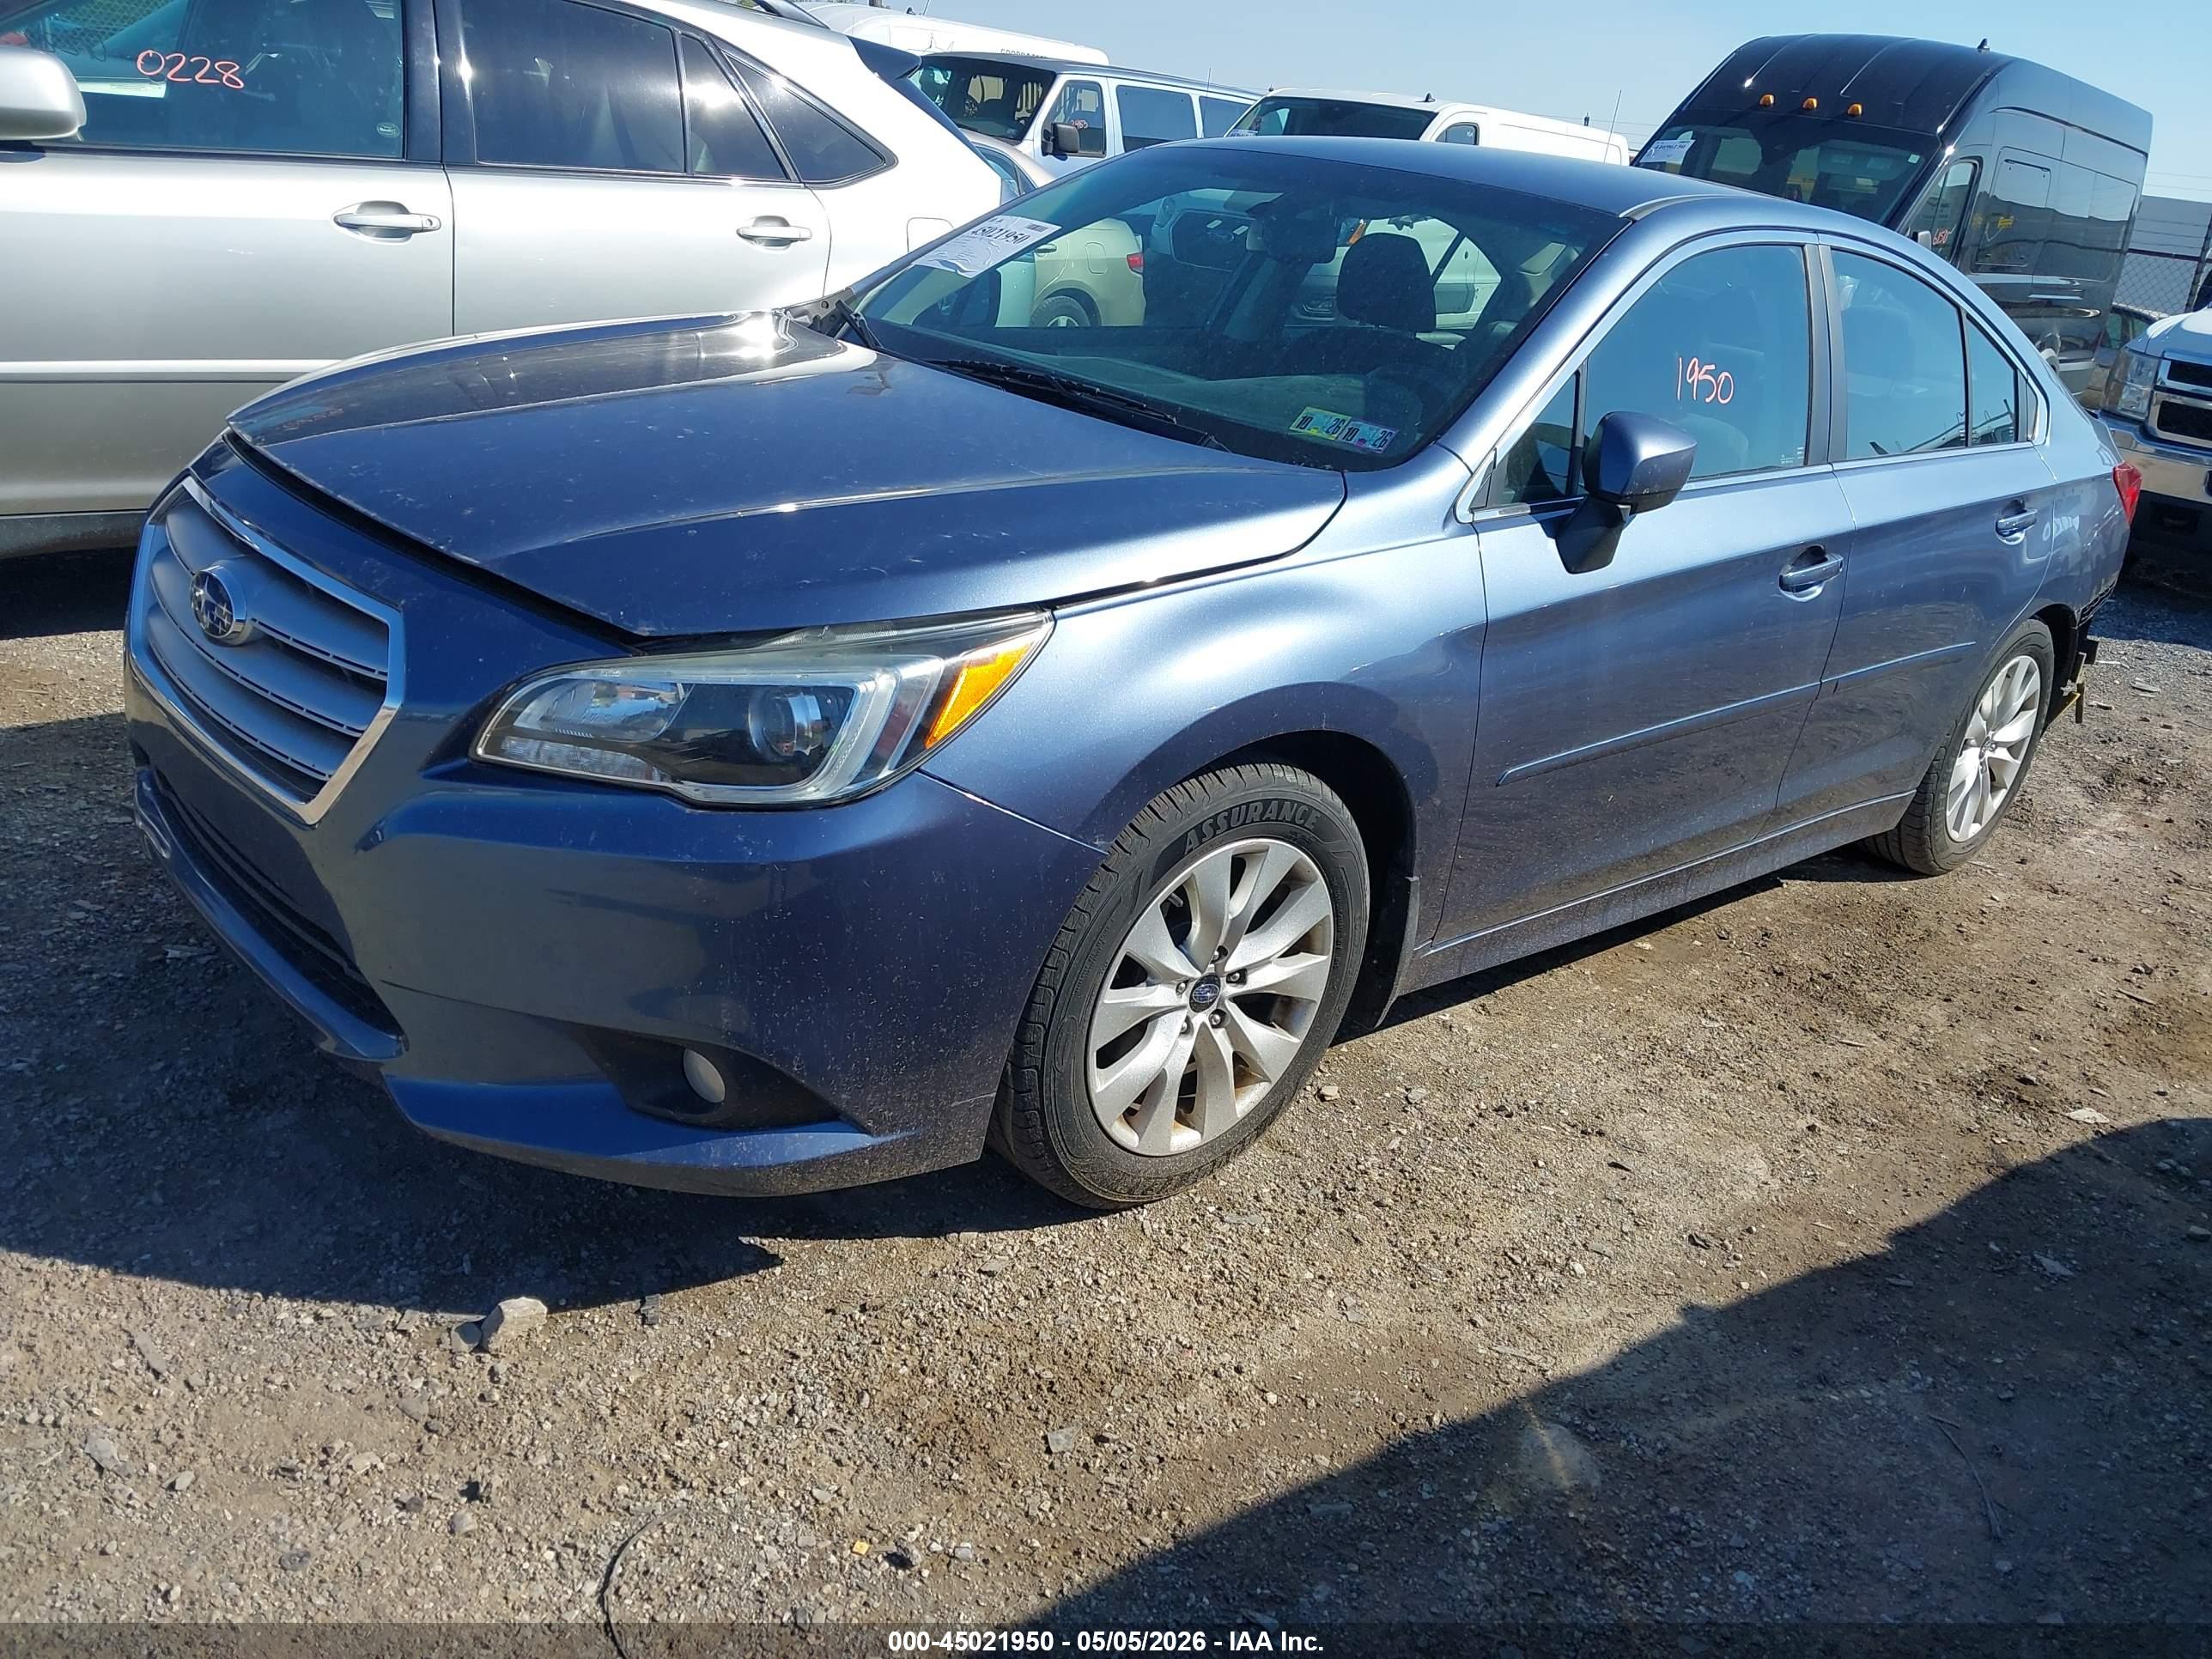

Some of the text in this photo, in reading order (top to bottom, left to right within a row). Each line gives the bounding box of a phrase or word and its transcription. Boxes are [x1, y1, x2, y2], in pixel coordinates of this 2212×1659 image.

[137, 49, 245, 89] 0228
[970, 225, 1031, 245] 45021950
[1677, 356, 1735, 404] 1950
[1296, 415, 1346, 434] 10 26
[1342, 426, 1393, 447] 10 26
[1183, 799, 1322, 856] ASSURANCE
